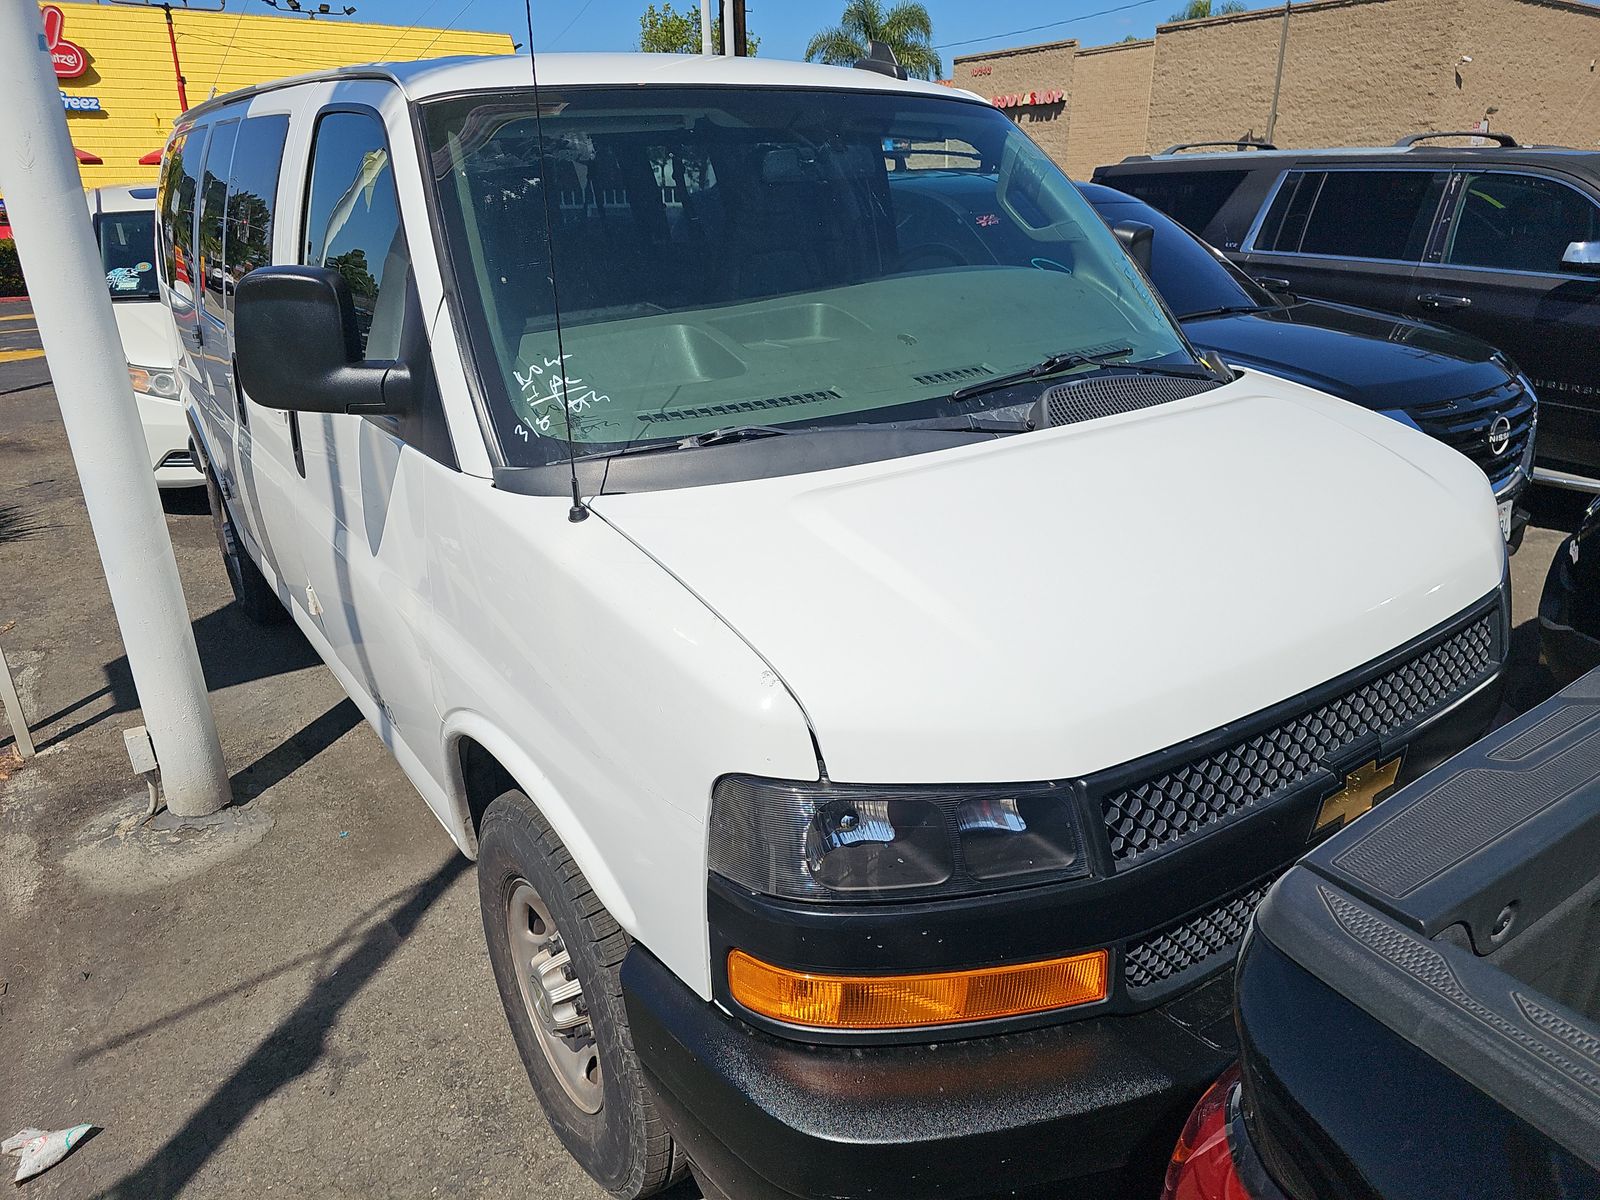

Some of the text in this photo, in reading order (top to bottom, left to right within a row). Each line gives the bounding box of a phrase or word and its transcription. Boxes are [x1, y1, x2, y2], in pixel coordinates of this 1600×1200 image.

[53, 53, 77, 66] itzel
[991, 88, 1063, 108] BODY SHOP
